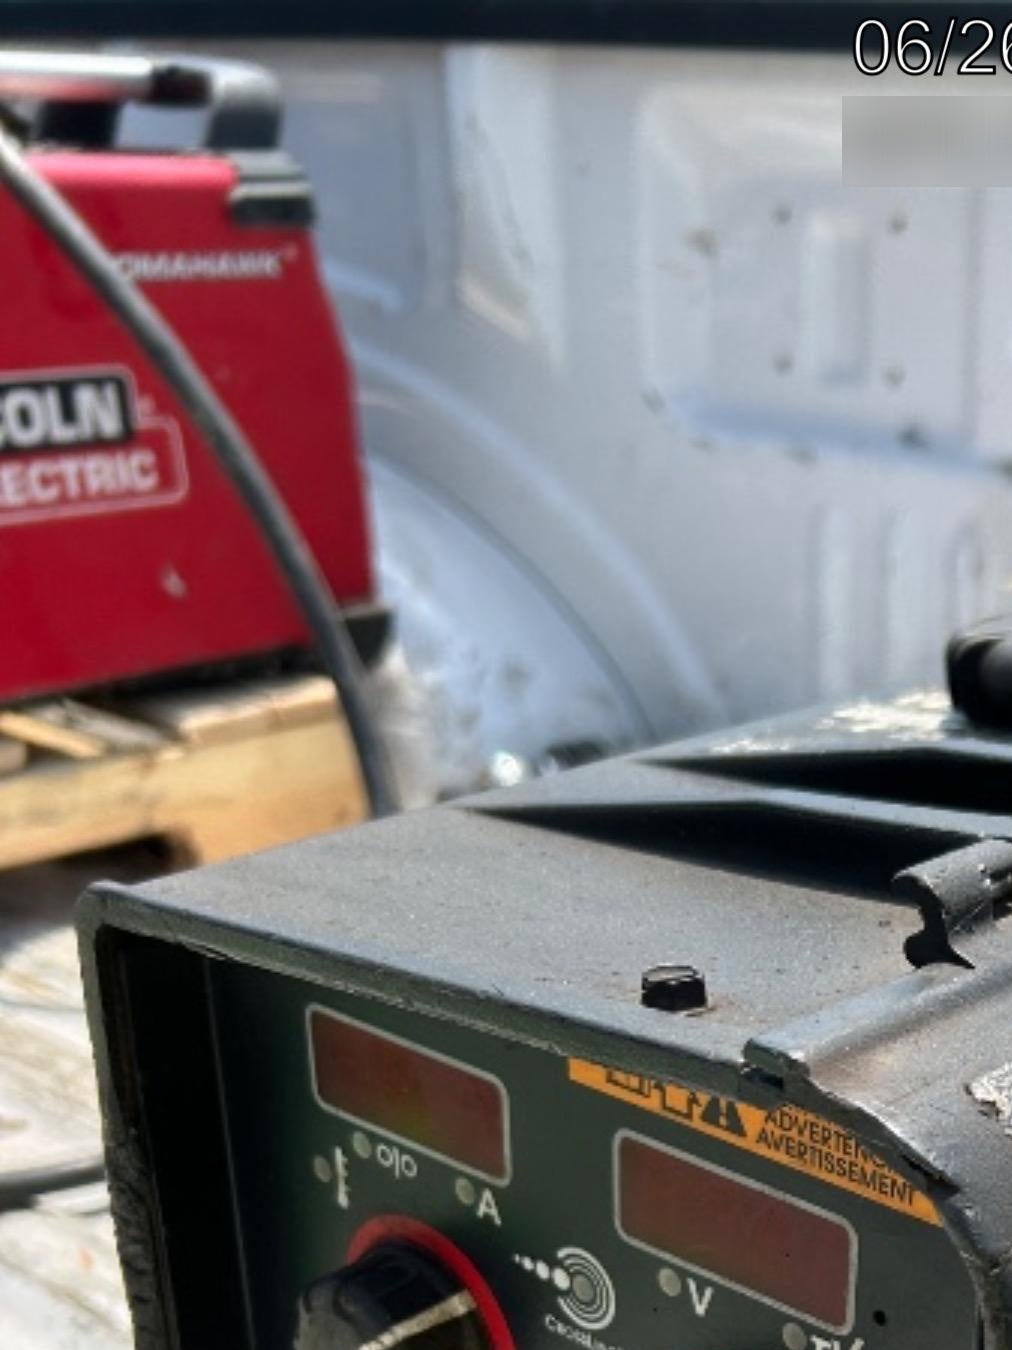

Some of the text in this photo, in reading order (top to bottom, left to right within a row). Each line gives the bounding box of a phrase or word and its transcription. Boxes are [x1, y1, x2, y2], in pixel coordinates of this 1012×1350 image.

[112, 250, 283, 284] OMAHAWK
[0, 381, 126, 448] OLN
[756, 1127, 914, 1206] AVERTISSEMENT
[475, 1187, 502, 1227] A
[685, 1277, 714, 1317] V
